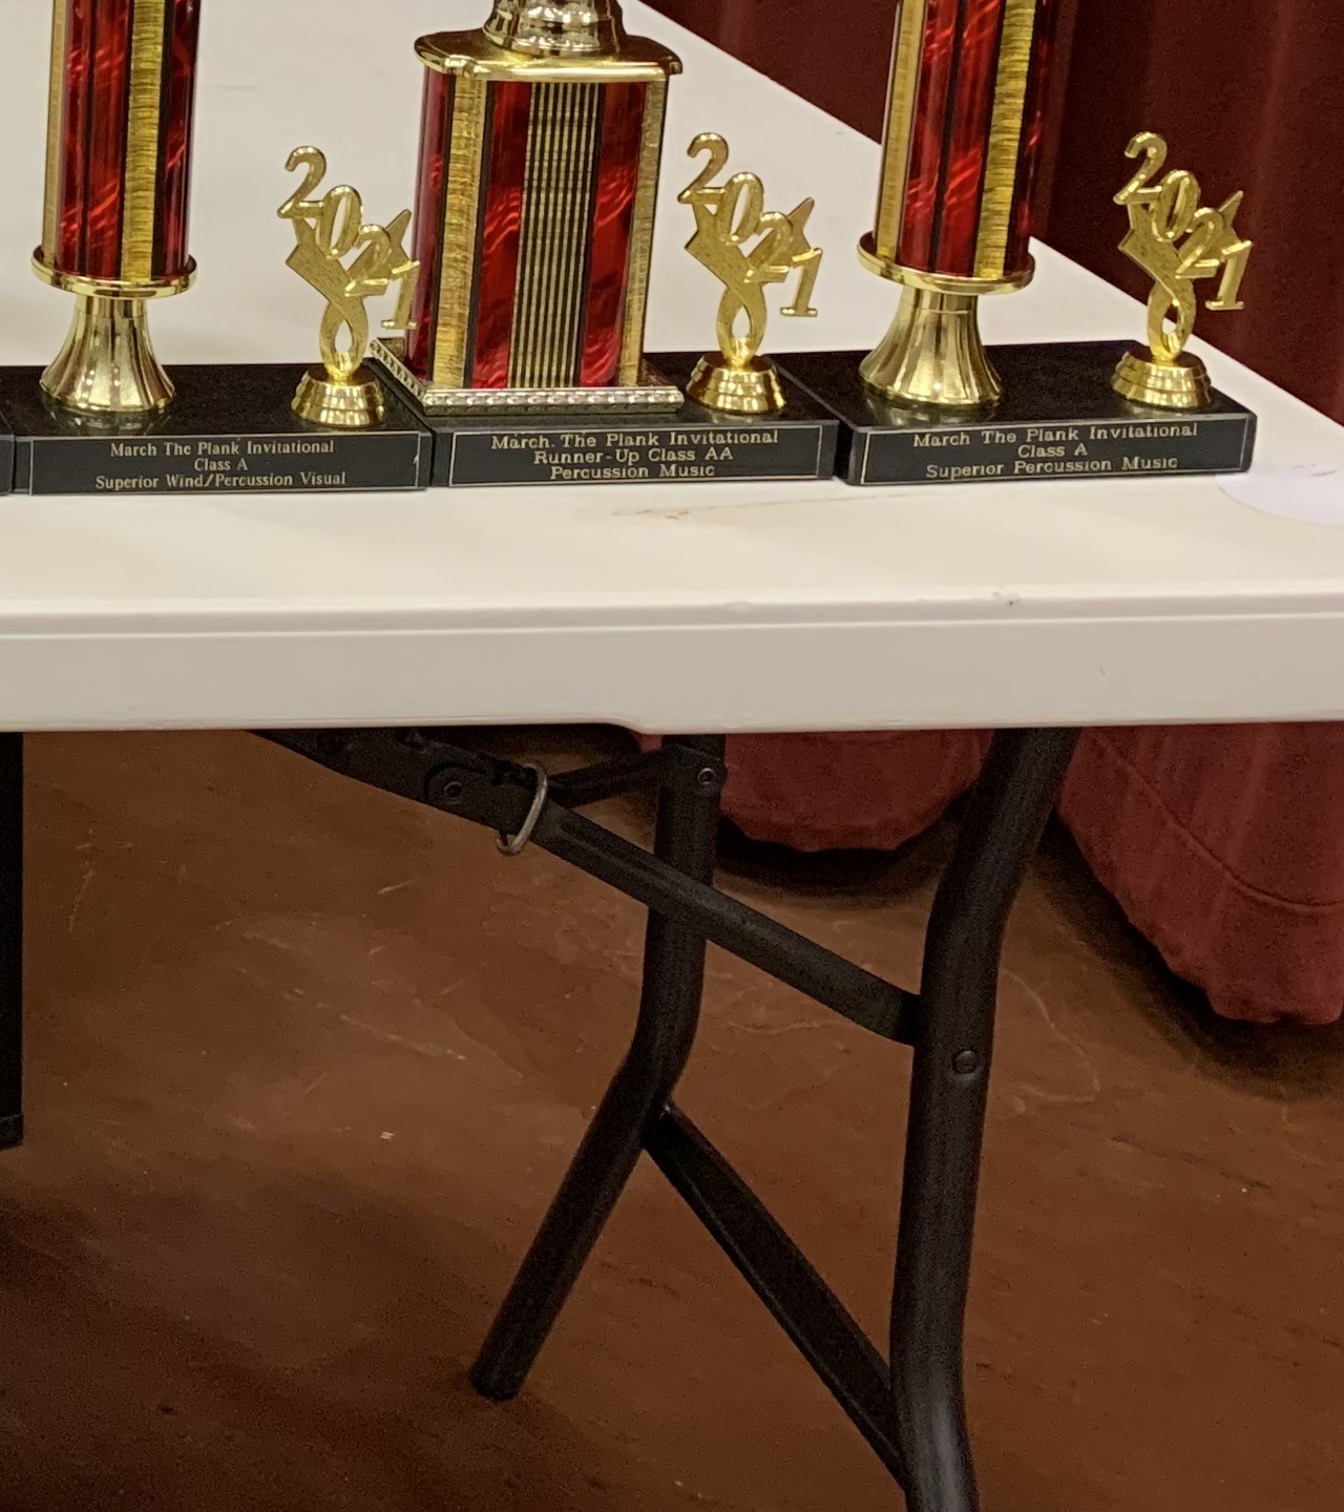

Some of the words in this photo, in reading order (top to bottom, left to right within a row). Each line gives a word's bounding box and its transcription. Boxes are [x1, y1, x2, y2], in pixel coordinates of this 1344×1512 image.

[678, 132, 823, 316] 2021
[1113, 132, 1251, 310] 2021
[277, 145, 419, 328] 2021
[491, 436, 551, 449] March
[561, 434, 597, 447] The
[606, 433, 659, 446] Plank
[670, 430, 778, 445] Invitational
[913, 433, 970, 447] March
[981, 431, 1016, 443] The
[1026, 428, 1079, 442] Plank
[1090, 422, 1198, 440] Invitational
[110, 443, 158, 457] March
[164, 442, 191, 455] The
[197, 441, 240, 455] Plank
[247, 440, 334, 454] Invitational
[534, 450, 639, 465] Runner-Up
[648, 448, 696, 461] Class
[705, 447, 733, 460] AA
[1018, 445, 1065, 457] Class
[1074, 443, 1088, 455] A
[194, 458, 231, 471] Class
[237, 458, 248, 470] A
[551, 465, 649, 478] Percussion
[659, 463, 715, 477] Music
[926, 464, 1004, 478] Superior
[1014, 459, 1112, 474] Percussion
[1121, 456, 1178, 469] Music
[95, 475, 159, 490] Superior
[166, 473, 292, 487] Wind/Percussion
[300, 472, 346, 485] Visual
